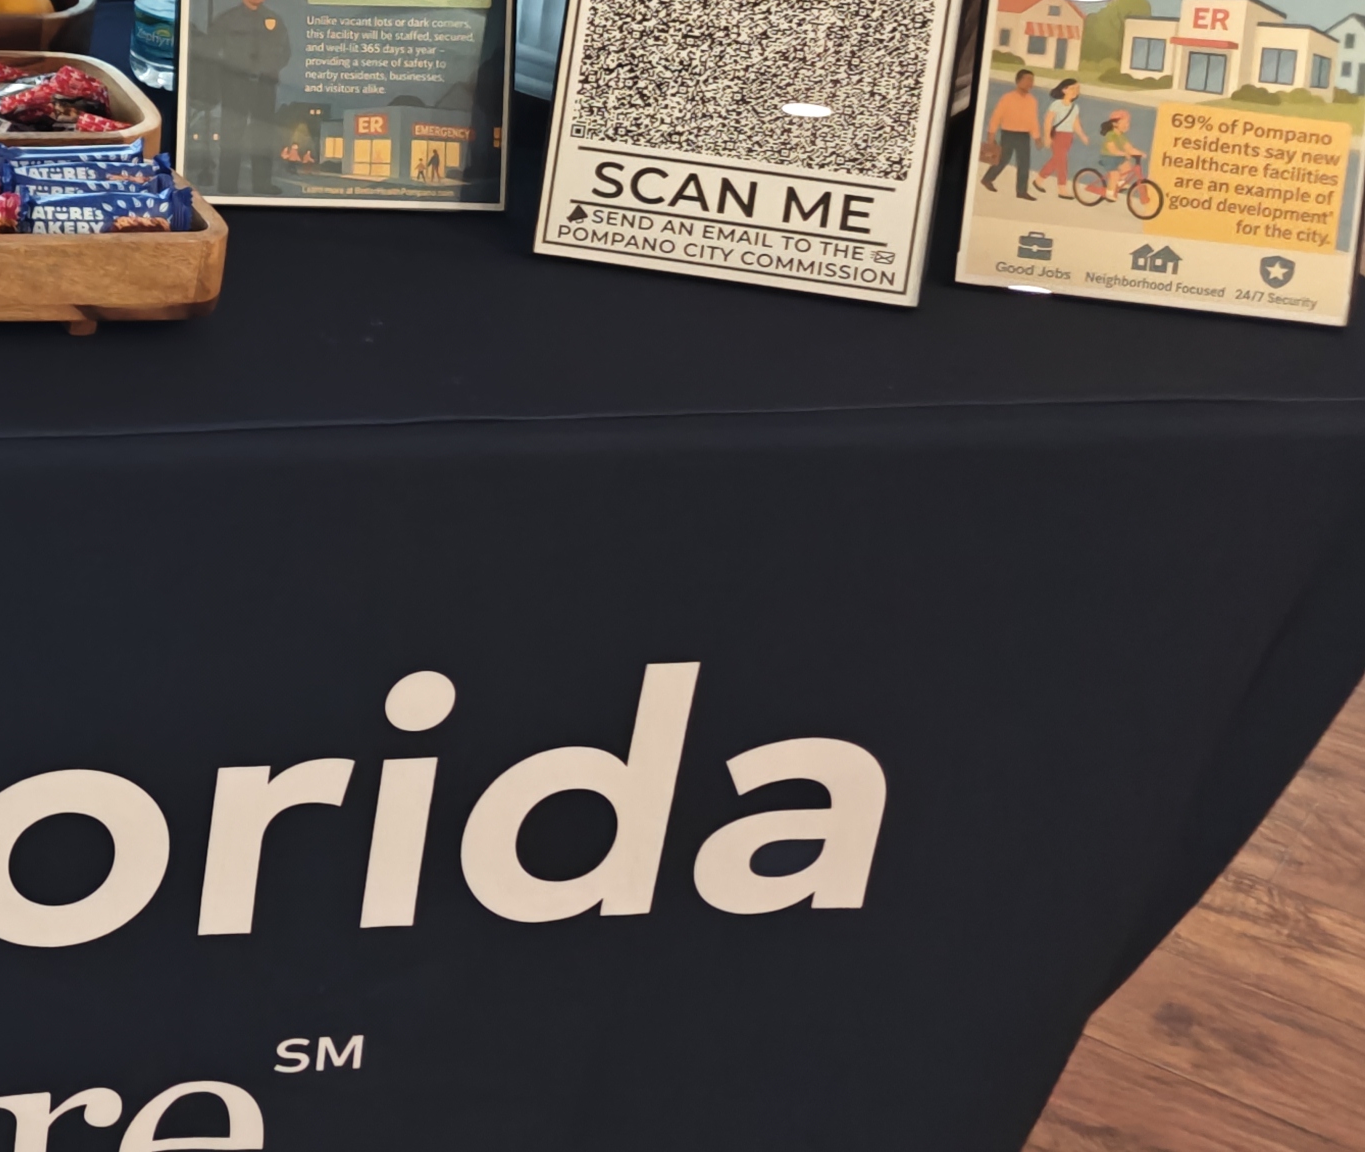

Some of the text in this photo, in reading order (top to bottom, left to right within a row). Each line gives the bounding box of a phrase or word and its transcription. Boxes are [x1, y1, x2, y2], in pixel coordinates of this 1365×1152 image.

[307, 16, 337, 25] Unlike
[340, 17, 371, 26] vacant
[374, 17, 392, 27] lots
[408, 19, 429, 27] dark
[1193, 7, 1230, 31] ER
[358, 117, 383, 133] ER
[415, 125, 470, 138] EMERGENCY
[1171, 113, 1332, 145] 69% of Pompano
[1173, 136, 1340, 166] residents say new
[1162, 152, 1338, 186] healthcare facilities
[591, 161, 875, 235] SCAN ME
[1174, 177, 1334, 205] are an example of
[592, 209, 865, 261] SEND AN EMAIL TO THE
[1236, 220, 1331, 247] for the city.
[558, 224, 896, 287] POMPANO CITY COMMISSION
[996, 261, 1071, 280] Good Jobs
[1085, 271, 1225, 298] Neighborhood Focused
[1234, 289, 1318, 310] 24/7 Security
[272, 1032, 366, 1076] SM
